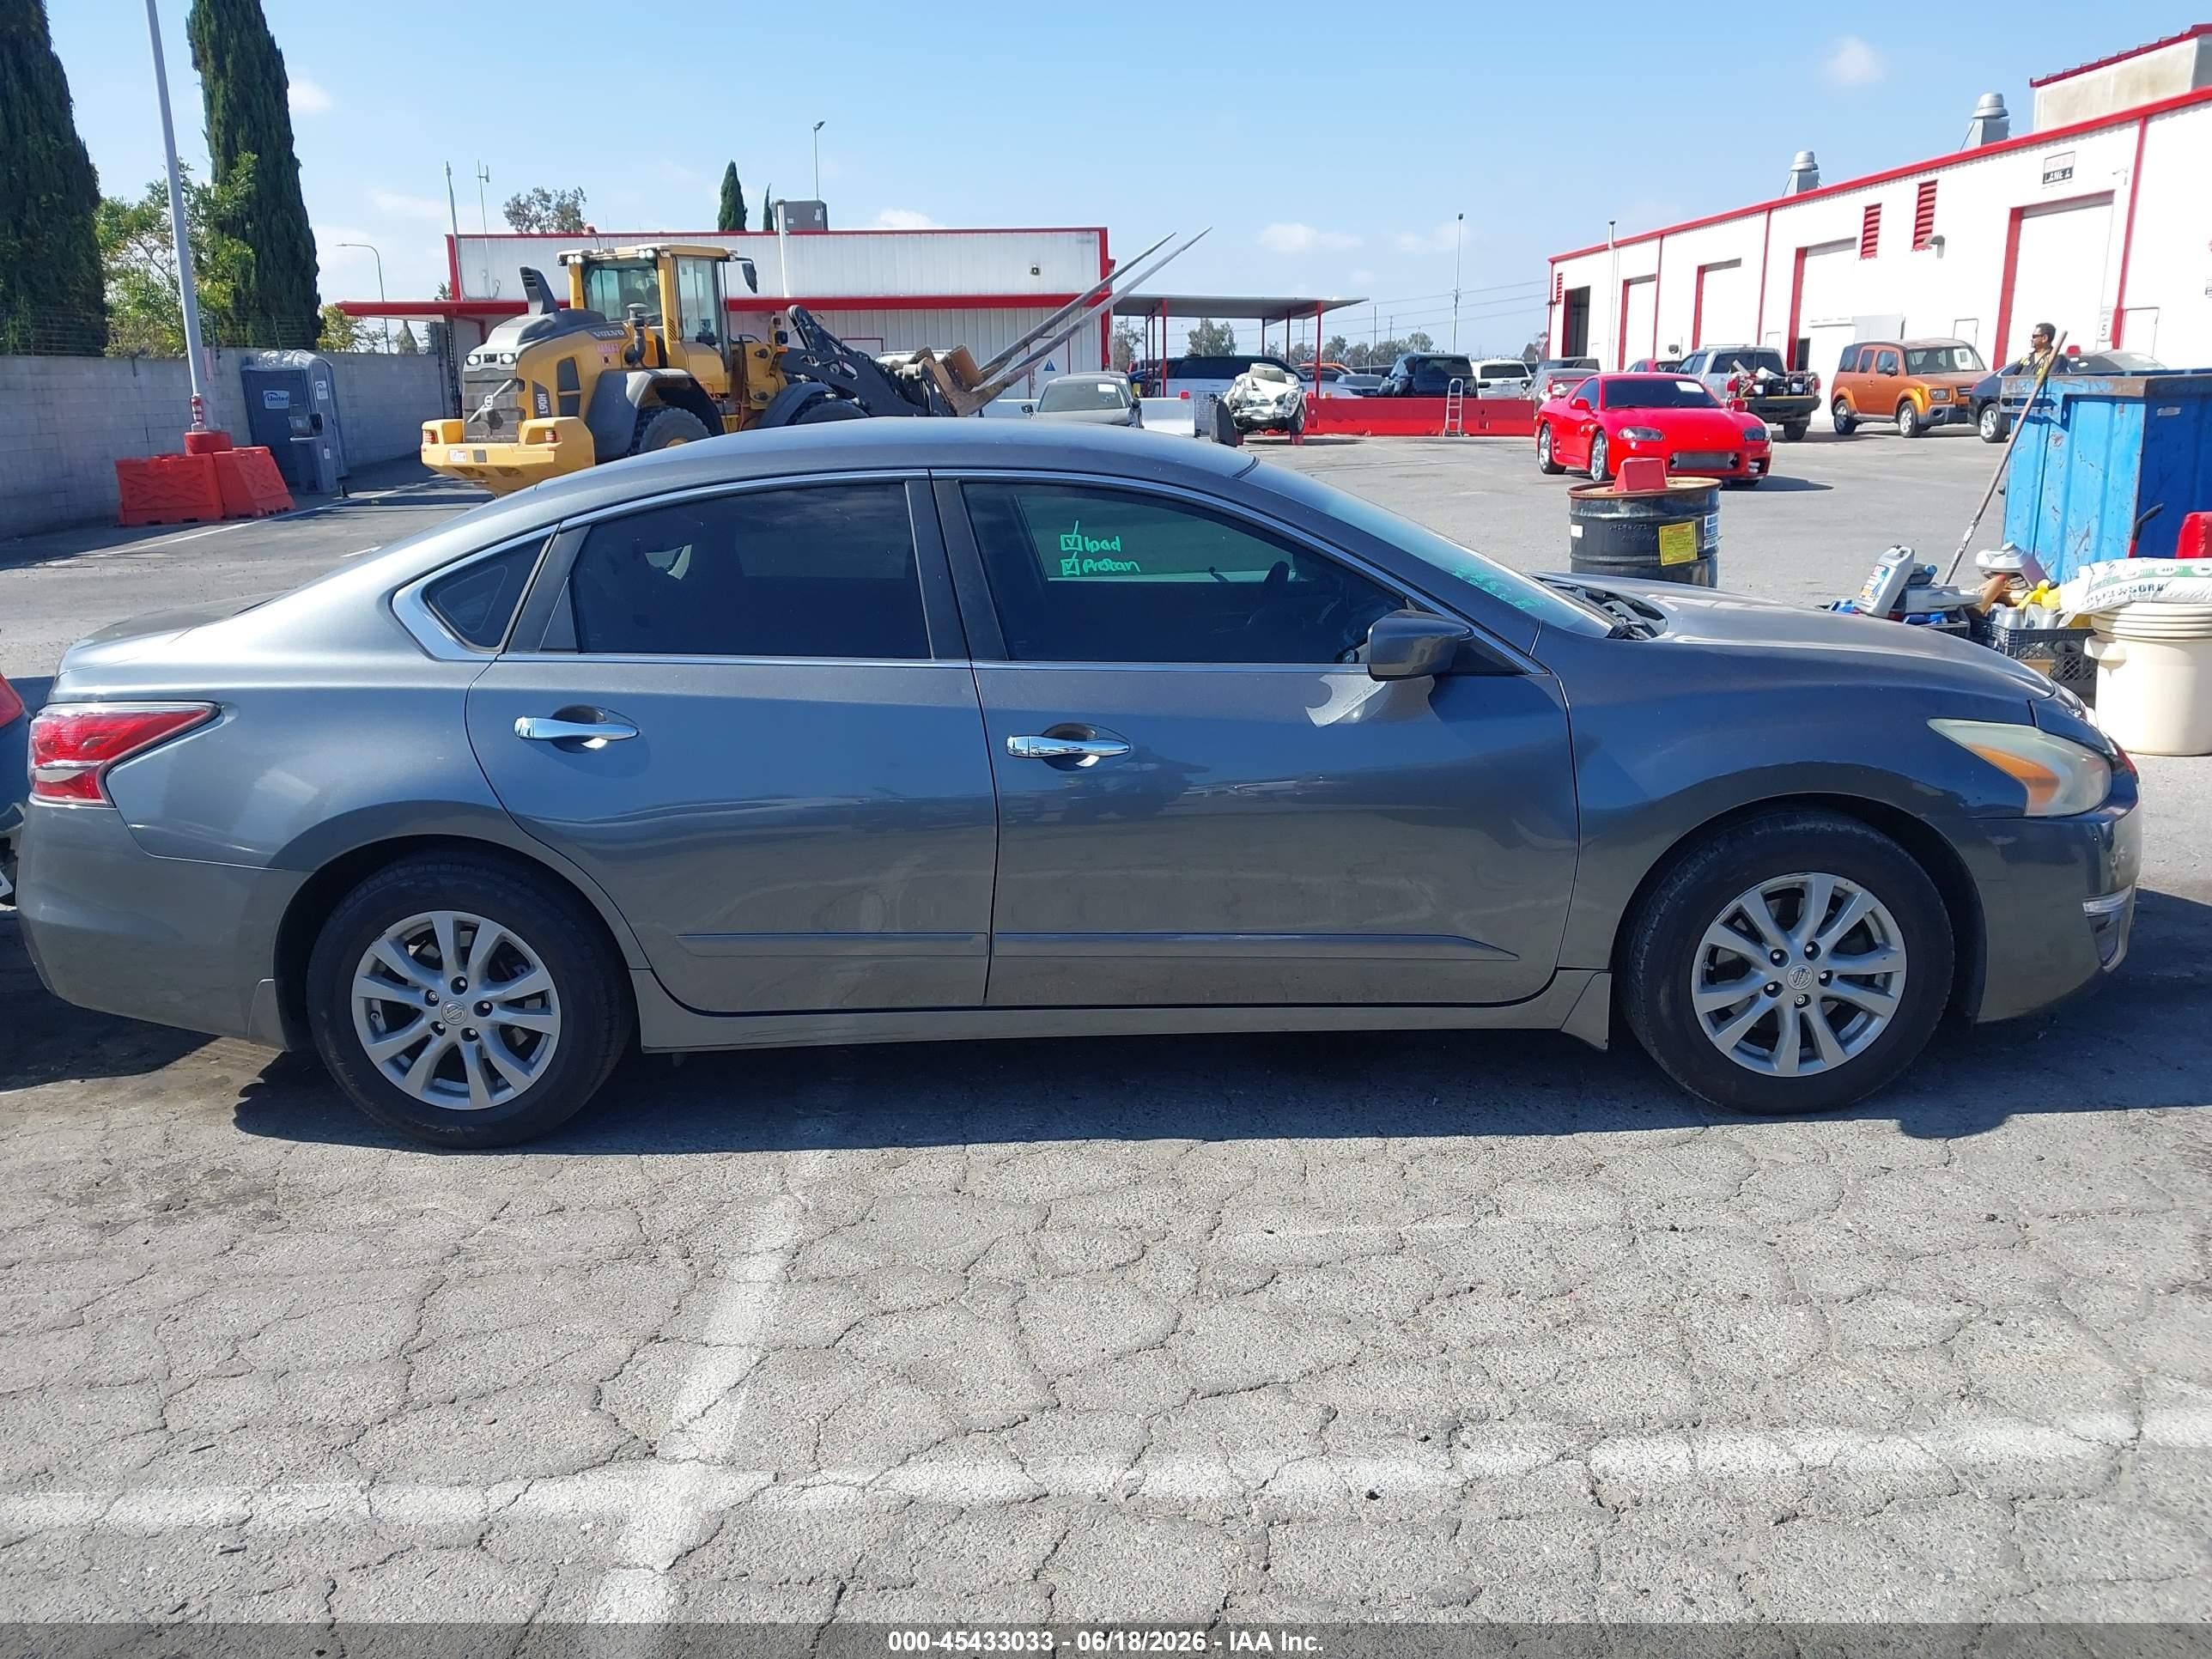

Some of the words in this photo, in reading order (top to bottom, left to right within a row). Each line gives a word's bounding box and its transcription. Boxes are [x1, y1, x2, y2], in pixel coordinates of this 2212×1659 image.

[593, 329, 625, 337] VOLVO
[2100, 324, 2107, 337] 5
[537, 393, 548, 414] L90H
